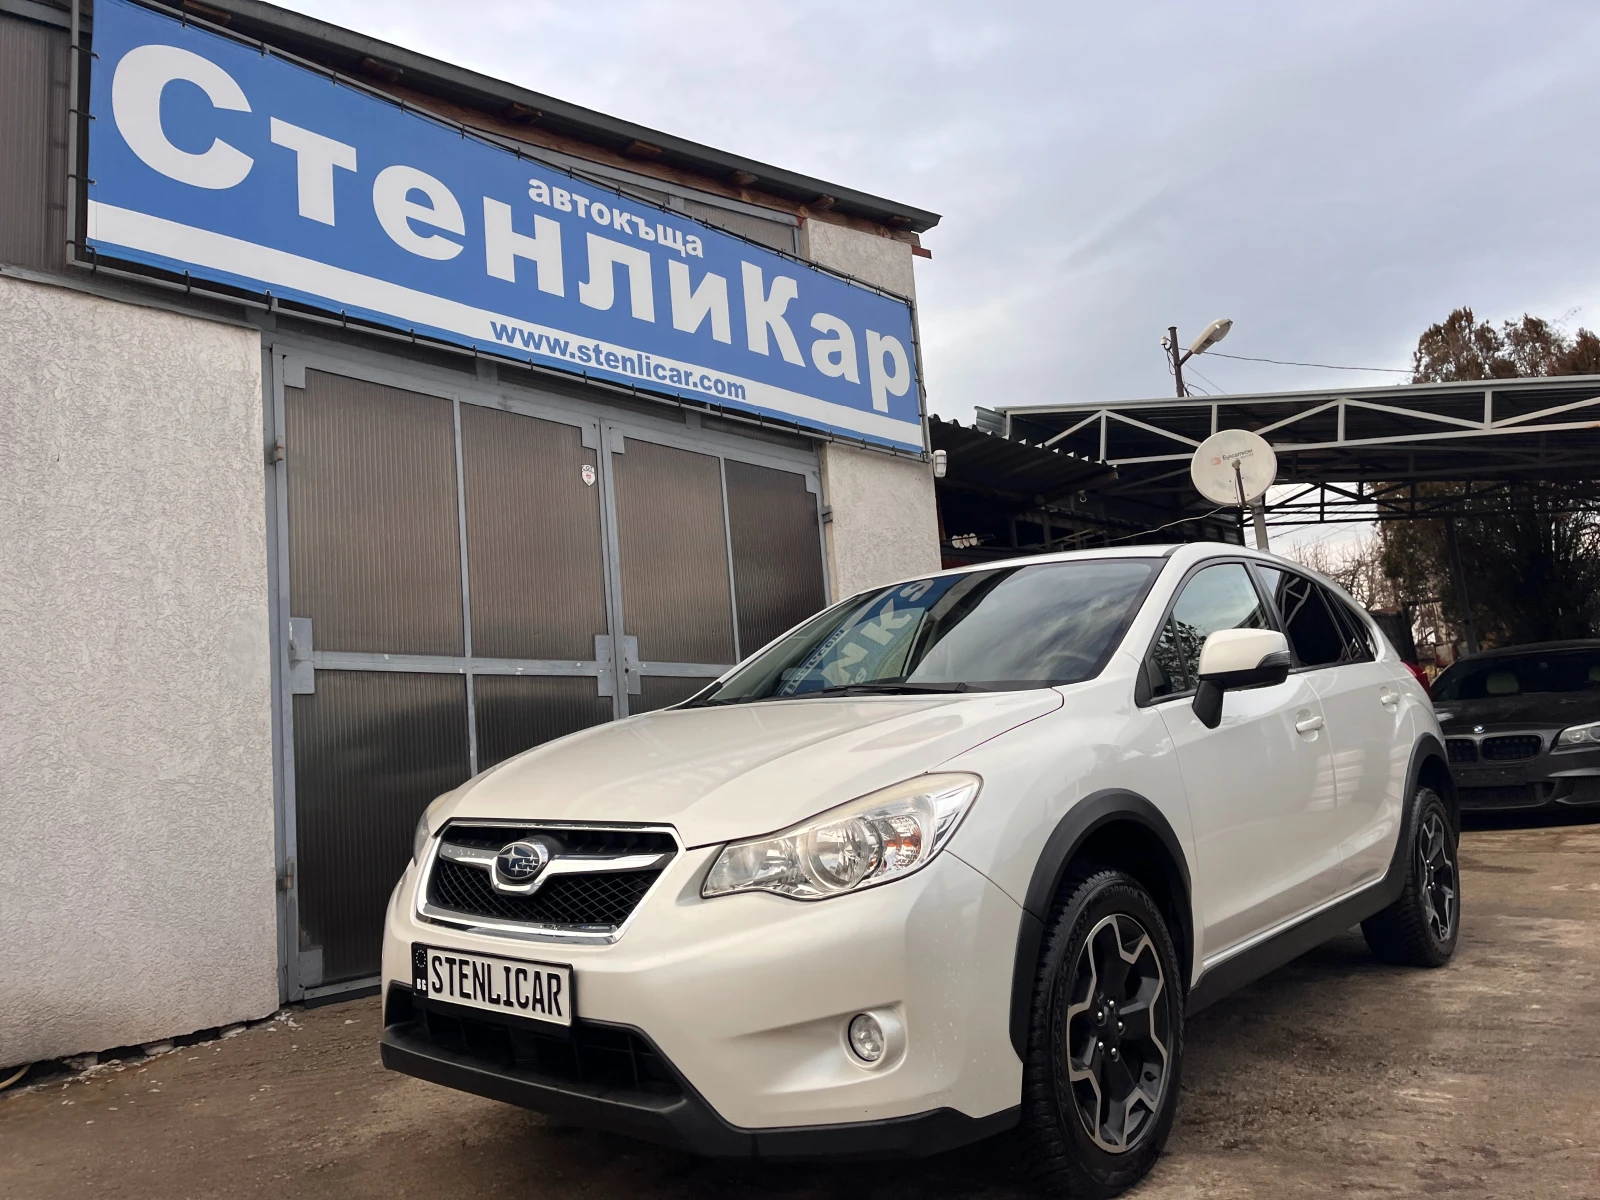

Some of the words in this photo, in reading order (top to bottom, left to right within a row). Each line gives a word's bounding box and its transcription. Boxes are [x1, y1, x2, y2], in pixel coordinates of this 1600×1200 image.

[111, 44, 910, 413] СтенлиКар
[528, 178, 704, 259] автокъща
[489, 320, 747, 401] www.stenlicar.com
[416, 978, 427, 991] BG
[431, 955, 562, 1017] STENLICAR
